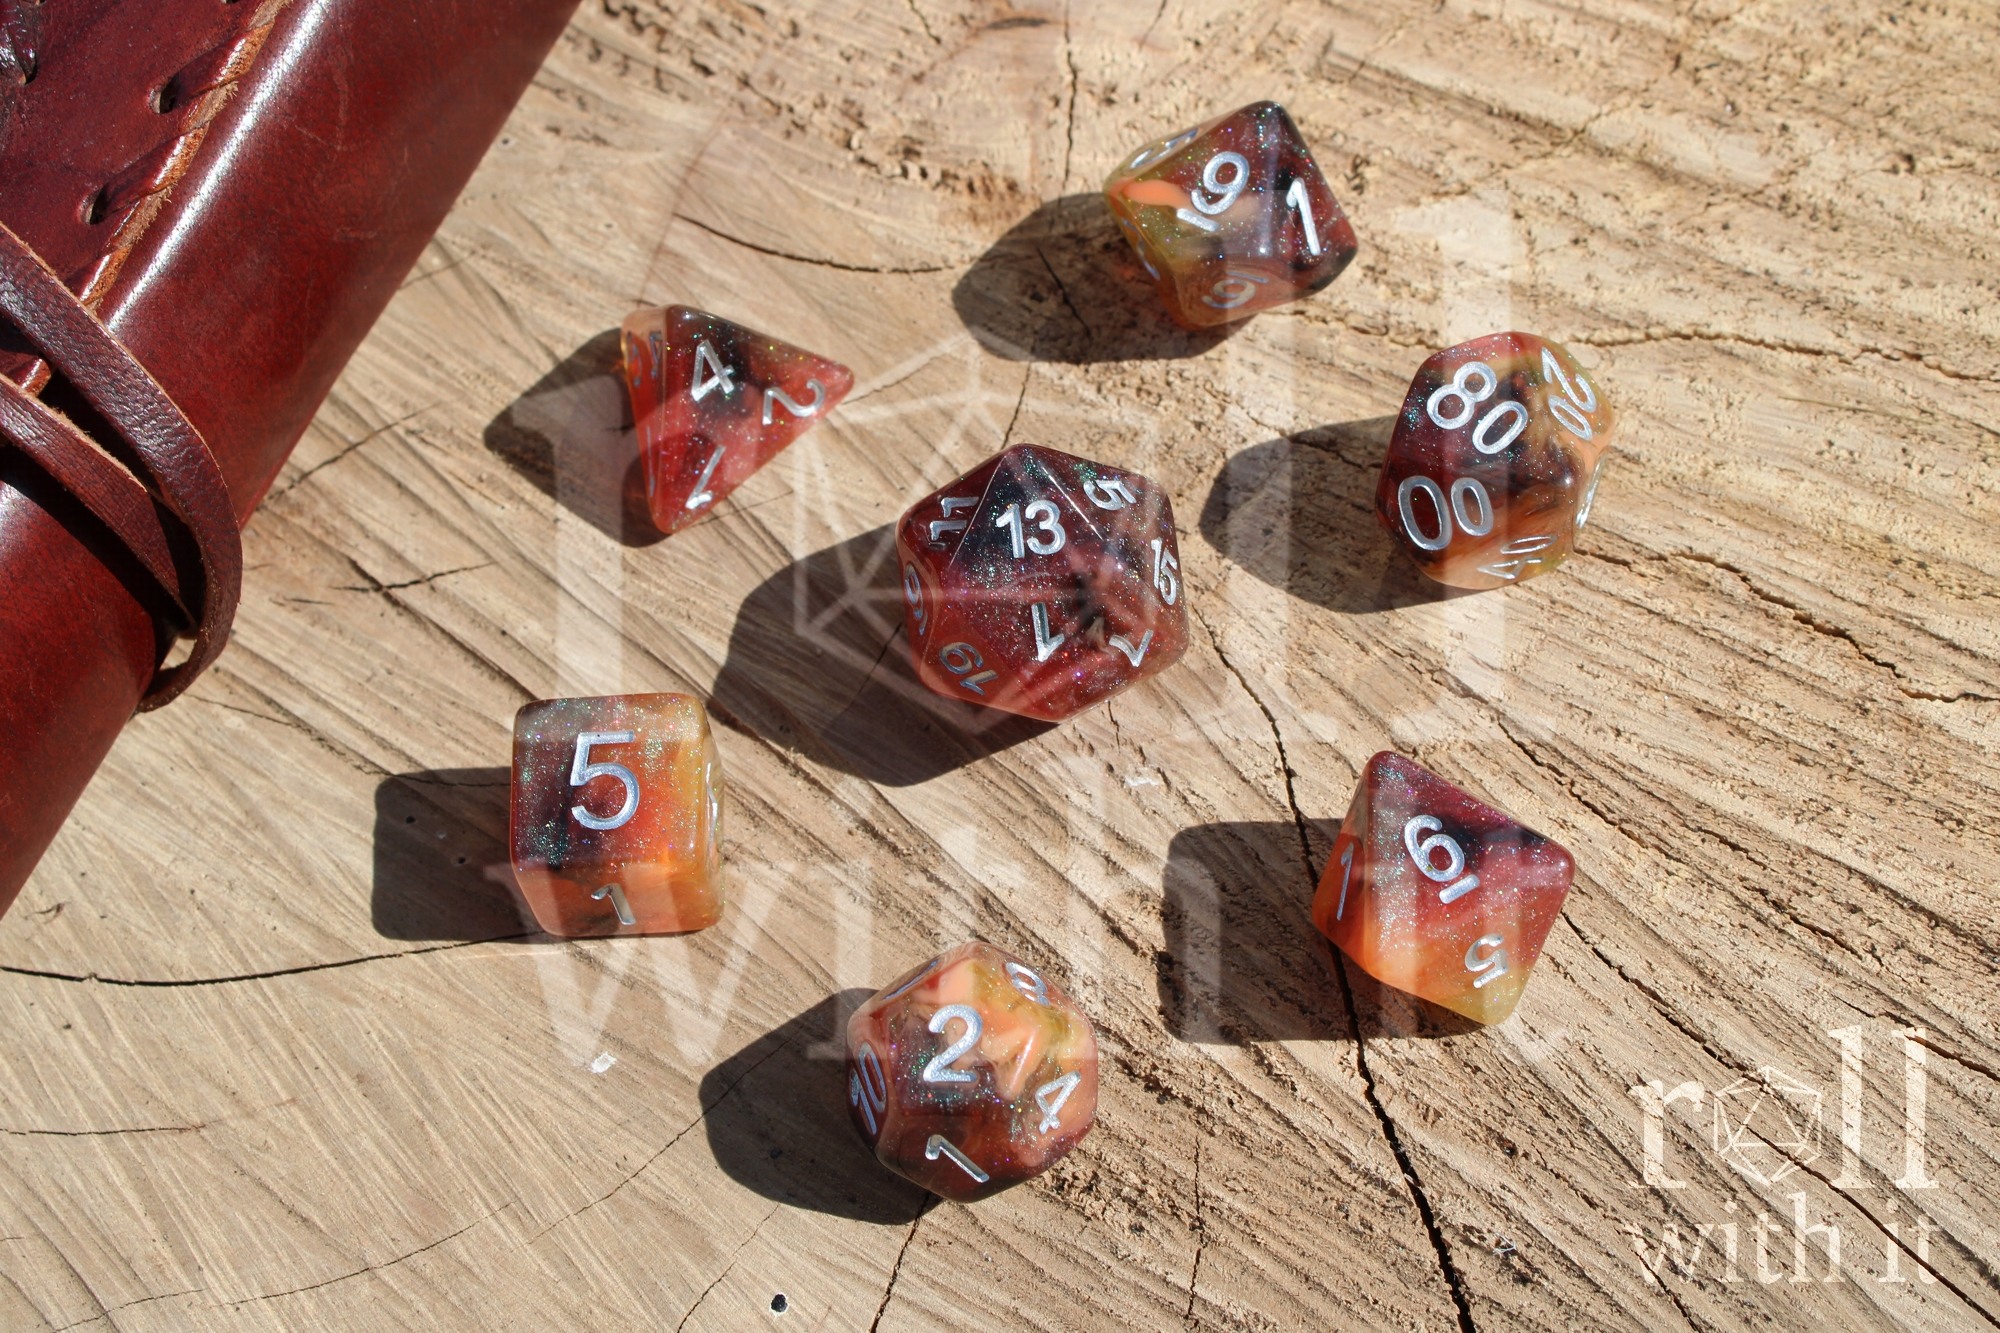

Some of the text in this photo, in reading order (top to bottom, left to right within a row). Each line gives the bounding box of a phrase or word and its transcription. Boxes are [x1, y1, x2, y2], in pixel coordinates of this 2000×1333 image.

[1176, 151, 1250, 232] 9
[1286, 177, 1321, 256] 1
[691, 339, 735, 401] 4
[762, 378, 826, 426] 2
[1541, 346, 1598, 441] 20
[1427, 361, 1529, 455] 80
[685, 445, 727, 510] 1
[1083, 479, 1138, 511] 5
[929, 496, 980, 541] 11
[995, 499, 1067, 559] 13
[1398, 475, 1495, 551] 00
[1151, 537, 1179, 606] 15
[1477, 534, 1558, 580] 40
[1031, 602, 1065, 662] 1
[939, 641, 999, 696] 19
[570, 730, 640, 830] 5
[1337, 841, 1354, 921] 1
[1404, 814, 1481, 904] 6
[590, 882, 636, 926] 1
[1464, 933, 1509, 989] 5
[923, 1004, 983, 1083] 2
[851, 1042, 886, 1135] 10
[1035, 1070, 1082, 1135] 4
[925, 1134, 990, 1183] 1
